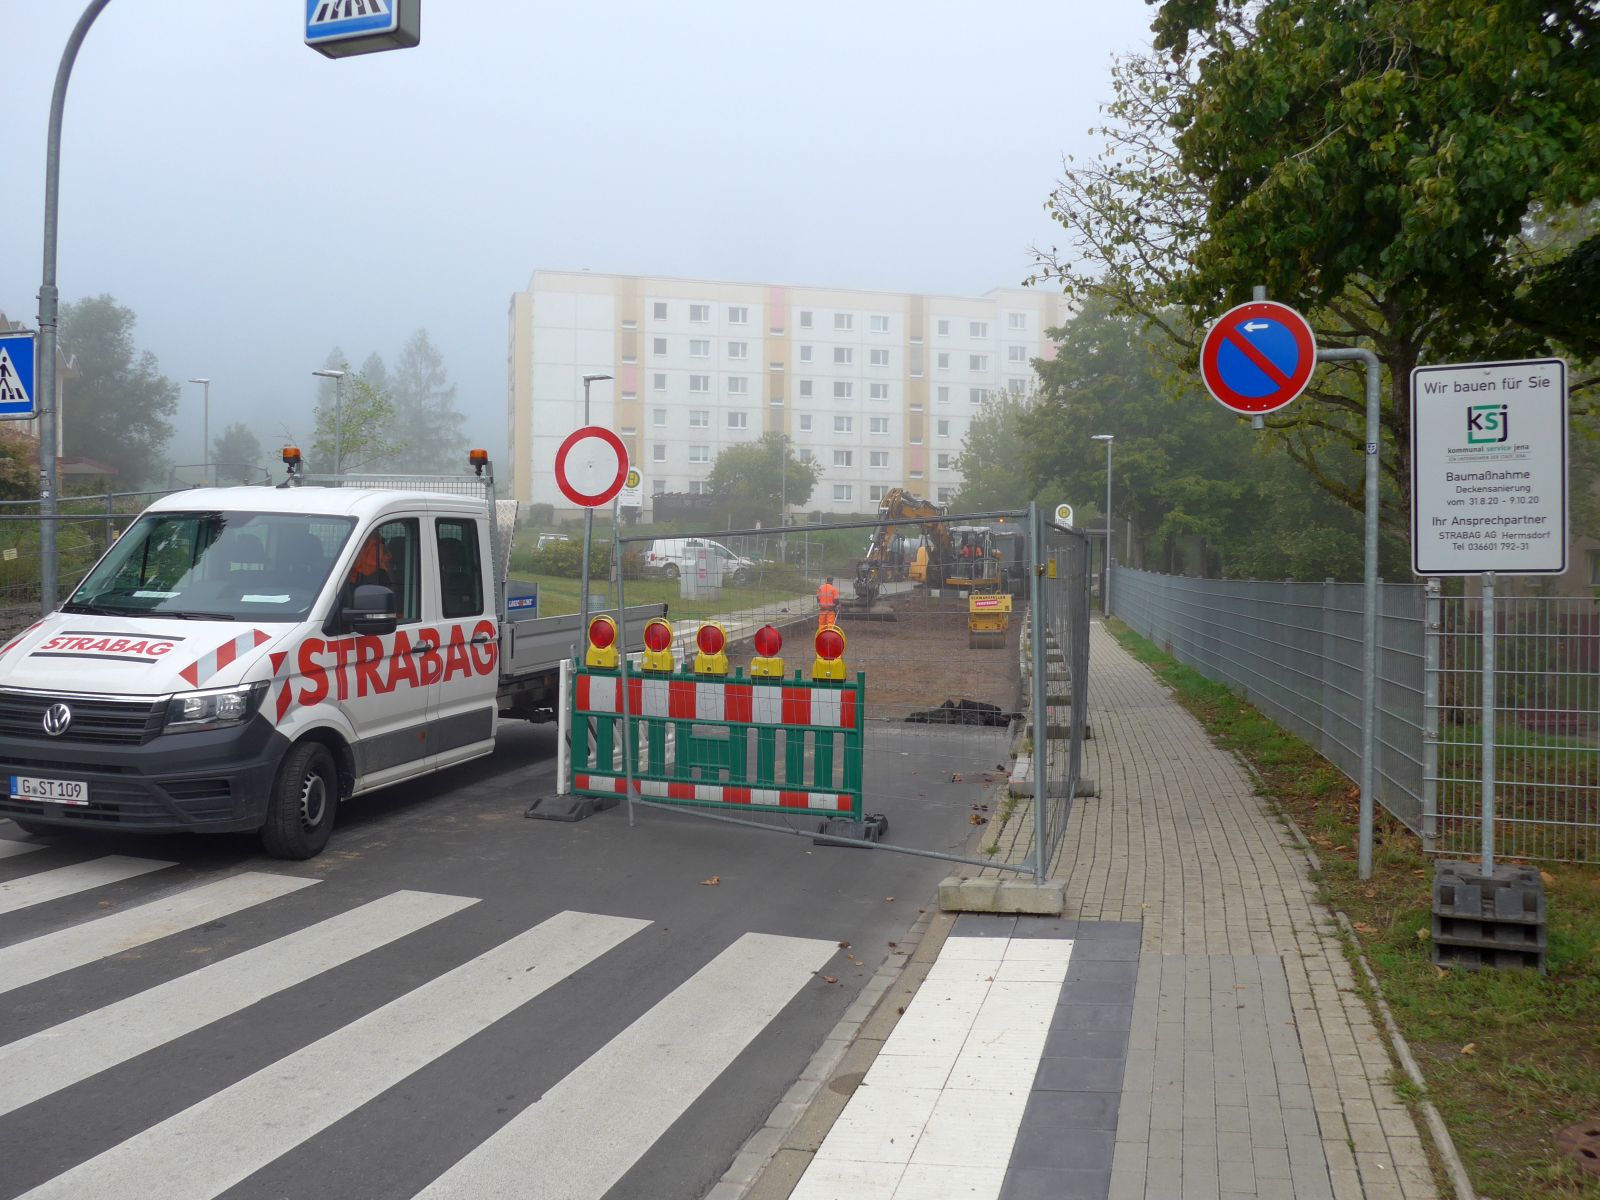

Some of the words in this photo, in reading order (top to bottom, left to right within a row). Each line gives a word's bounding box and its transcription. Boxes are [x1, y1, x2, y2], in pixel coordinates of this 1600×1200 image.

[1424, 381, 1448, 394] Wir
[1453, 381, 1496, 393] bauen
[1502, 377, 1522, 390] für
[1528, 376, 1550, 388] Sie
[1467, 404, 1508, 443] ksj
[1447, 446, 1484, 454] kommunal
[1513, 444, 1530, 452] jena
[1446, 470, 1530, 482] Baumaßnahme
[1455, 485, 1531, 494] Deckensanierung
[1469, 496, 1499, 506] 31.8.20
[1509, 496, 1540, 504] 9.10.20
[1432, 516, 1447, 526] Ihr
[1451, 515, 1547, 527] Ansprechpartner
[1439, 531, 1481, 540] STRABAG
[1484, 530, 1497, 539] AG
[1502, 530, 1551, 540] Hermsdorf
[1452, 543, 1464, 551] Tel
[1468, 542, 1498, 551] 036601
[1500, 542, 1530, 551] 792-31
[40, 636, 174, 656] STRABAG
[298, 619, 498, 707] STRABAG
[22, 779, 31, 794] G
[39, 780, 55, 796] ST
[58, 782, 82, 798] 109
